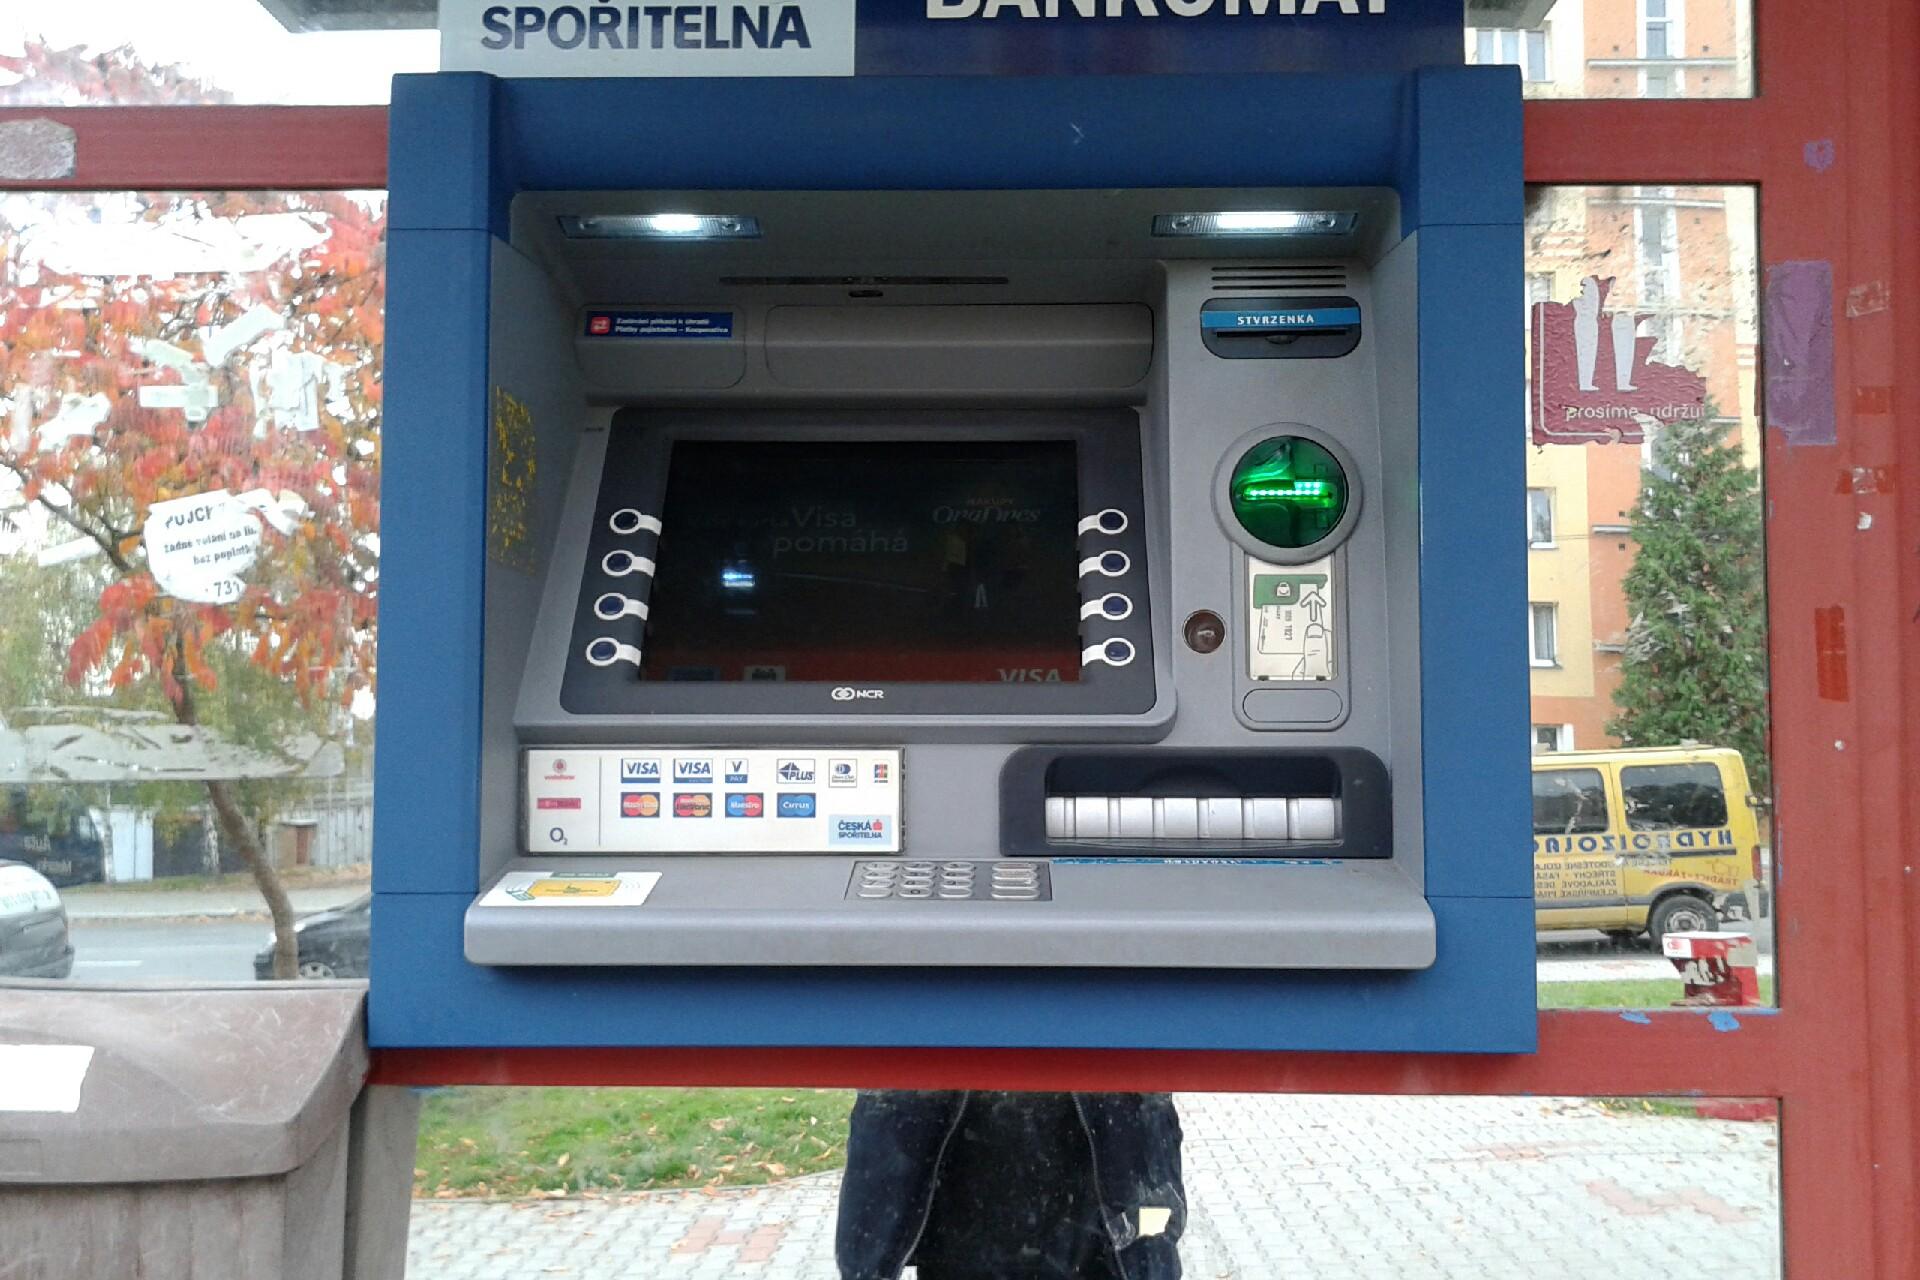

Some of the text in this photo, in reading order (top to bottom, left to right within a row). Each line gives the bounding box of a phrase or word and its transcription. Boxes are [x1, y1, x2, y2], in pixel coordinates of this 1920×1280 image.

[1237, 314, 1314, 326] STVRZENKA
[789, 507, 857, 528] Visa
[773, 530, 909, 558] pomáhá
[996, 668, 1061, 682] VISA
[856, 689, 884, 699] NCR
[626, 762, 659, 775] VISA
[678, 762, 711, 775] VISA
[788, 771, 814, 781] PLUS
[838, 819, 872, 831] ČESKÁ
